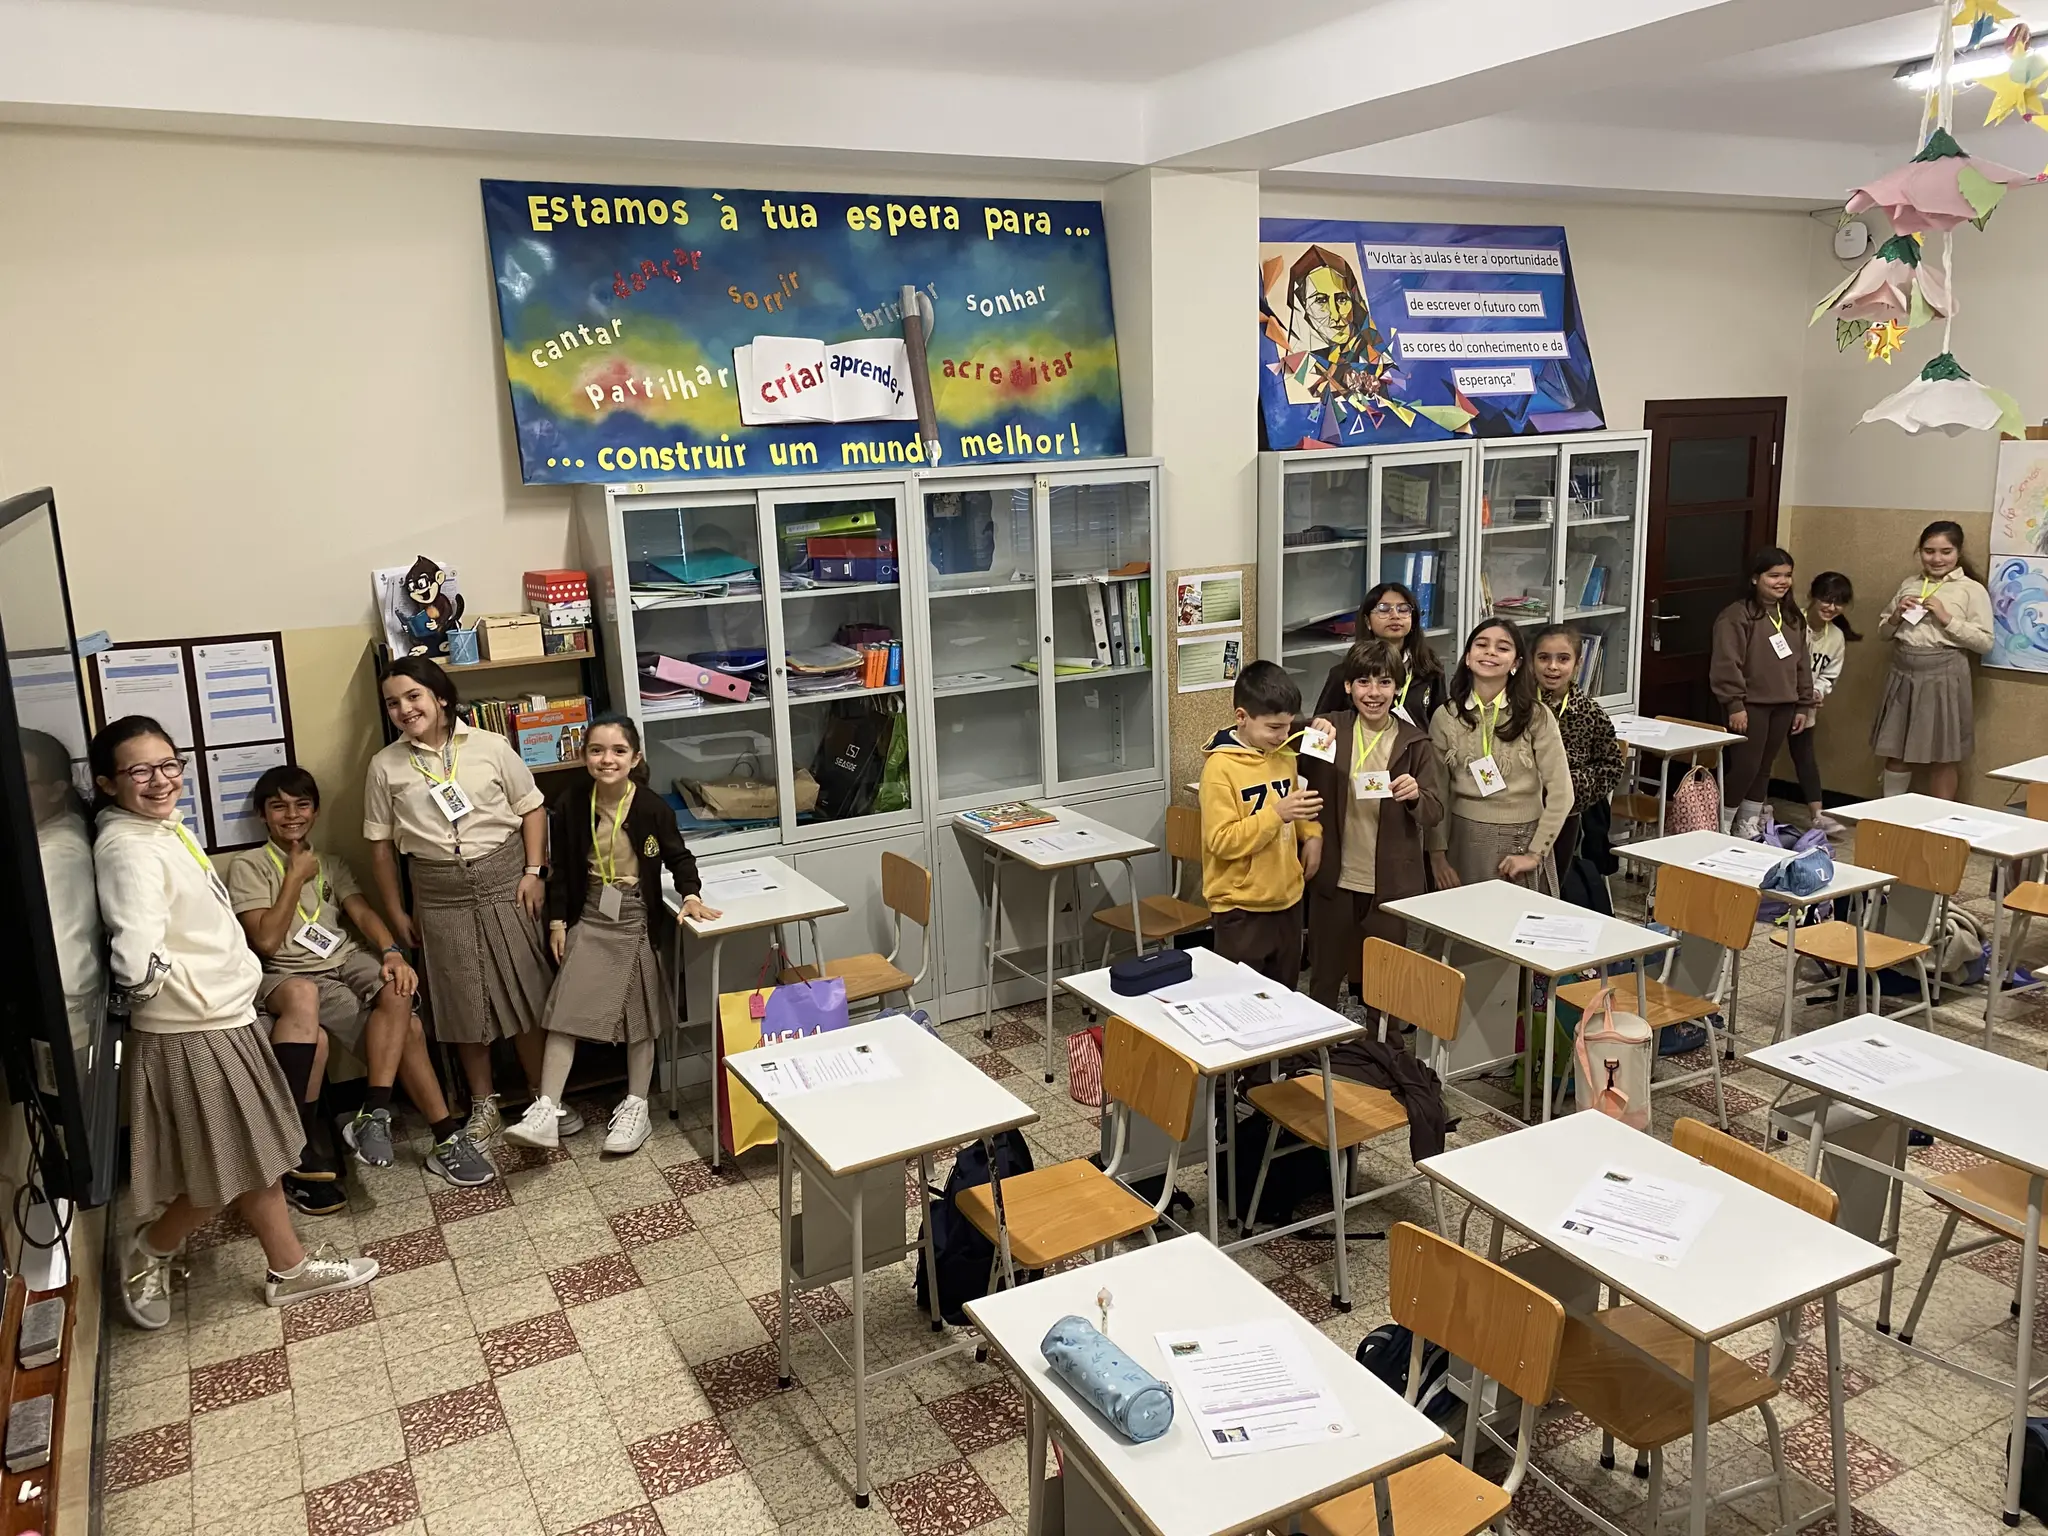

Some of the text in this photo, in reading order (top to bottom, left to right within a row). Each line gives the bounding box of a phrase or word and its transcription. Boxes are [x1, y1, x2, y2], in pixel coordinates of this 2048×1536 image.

[527, 194, 689, 232] Estamos
[711, 193, 738, 232] à
[761, 199, 818, 230] tua
[846, 203, 960, 236] espera
[984, 206, 1051, 240] para
[612, 248, 702, 299] dançar
[1410, 252, 1422, 265] às
[1424, 252, 1452, 265] aulas
[1454, 252, 1461, 265] é
[1463, 254, 1479, 265] ter
[1481, 256, 1488, 265] a
[1490, 253, 1559, 268] oportunidade
[728, 271, 799, 314] sorrir
[966, 284, 1047, 318] sonhar
[1410, 298, 1541, 313] de escrever o futuro com
[531, 316, 624, 368] cantar
[1402, 339, 1563, 354] as cores do conhecimento e da
[585, 363, 729, 410] partilhar
[760, 359, 826, 404] criar
[830, 354, 904, 405] aprender
[942, 351, 1074, 386] acreditar
[597, 434, 746, 472] construir
[769, 440, 818, 466] um
[961, 422, 1081, 458] melhor!
[1038, 480, 1047, 489] 14
